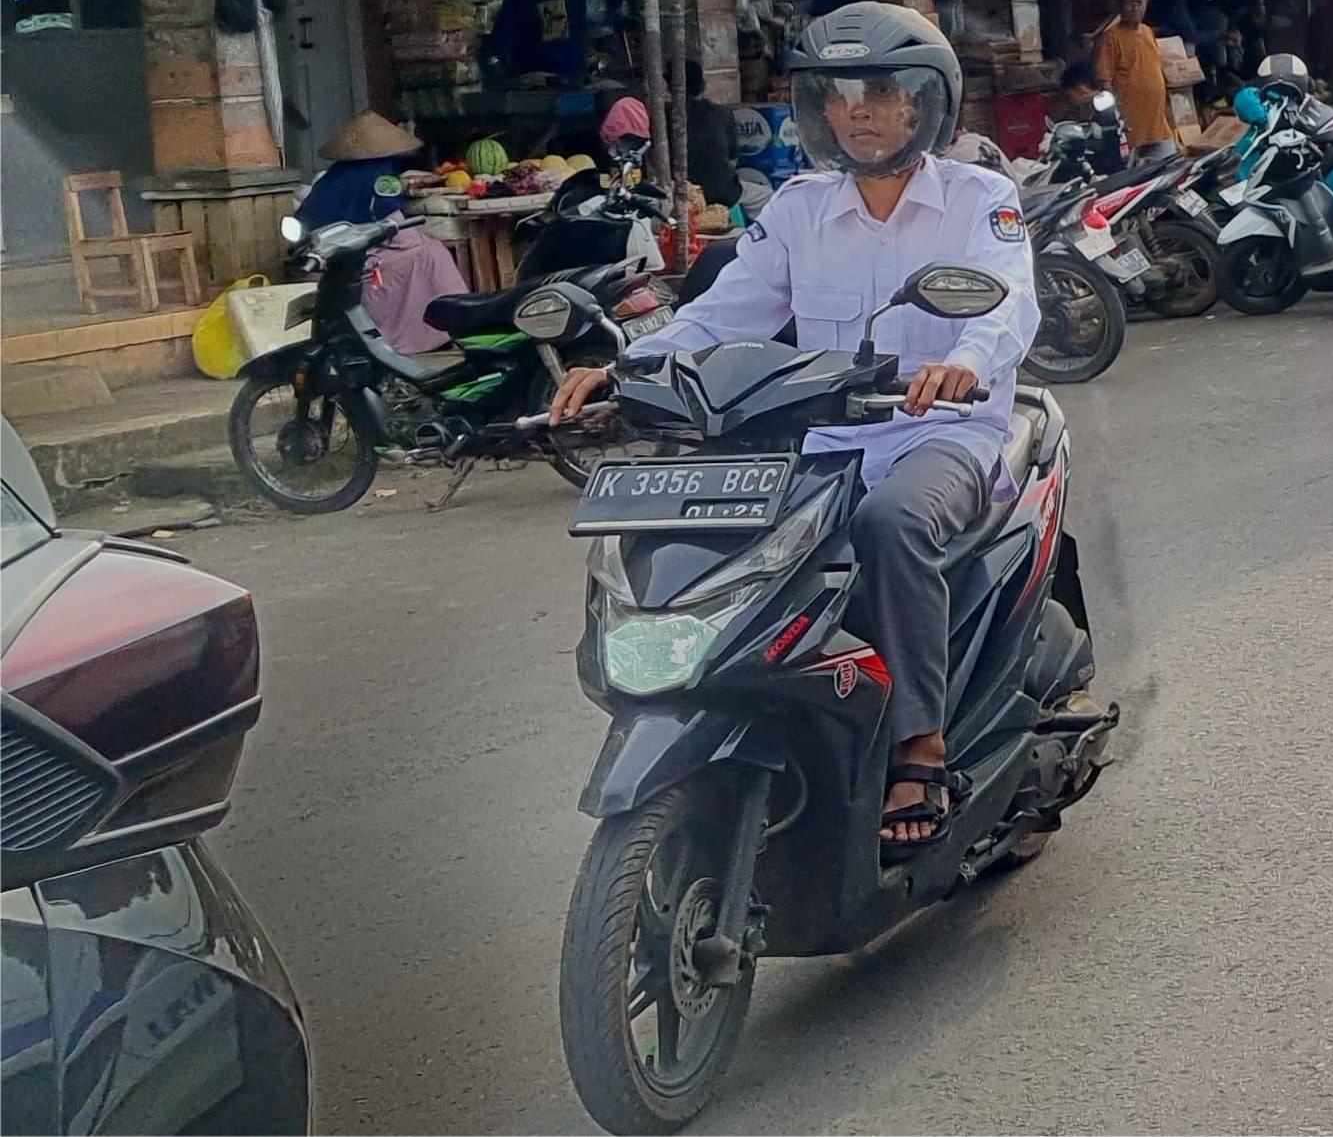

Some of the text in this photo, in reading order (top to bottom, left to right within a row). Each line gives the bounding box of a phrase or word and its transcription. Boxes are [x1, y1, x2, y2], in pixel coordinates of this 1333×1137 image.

[599, 467, 778, 497] K 3356 BCC
[763, 613, 811, 665] HONDA
